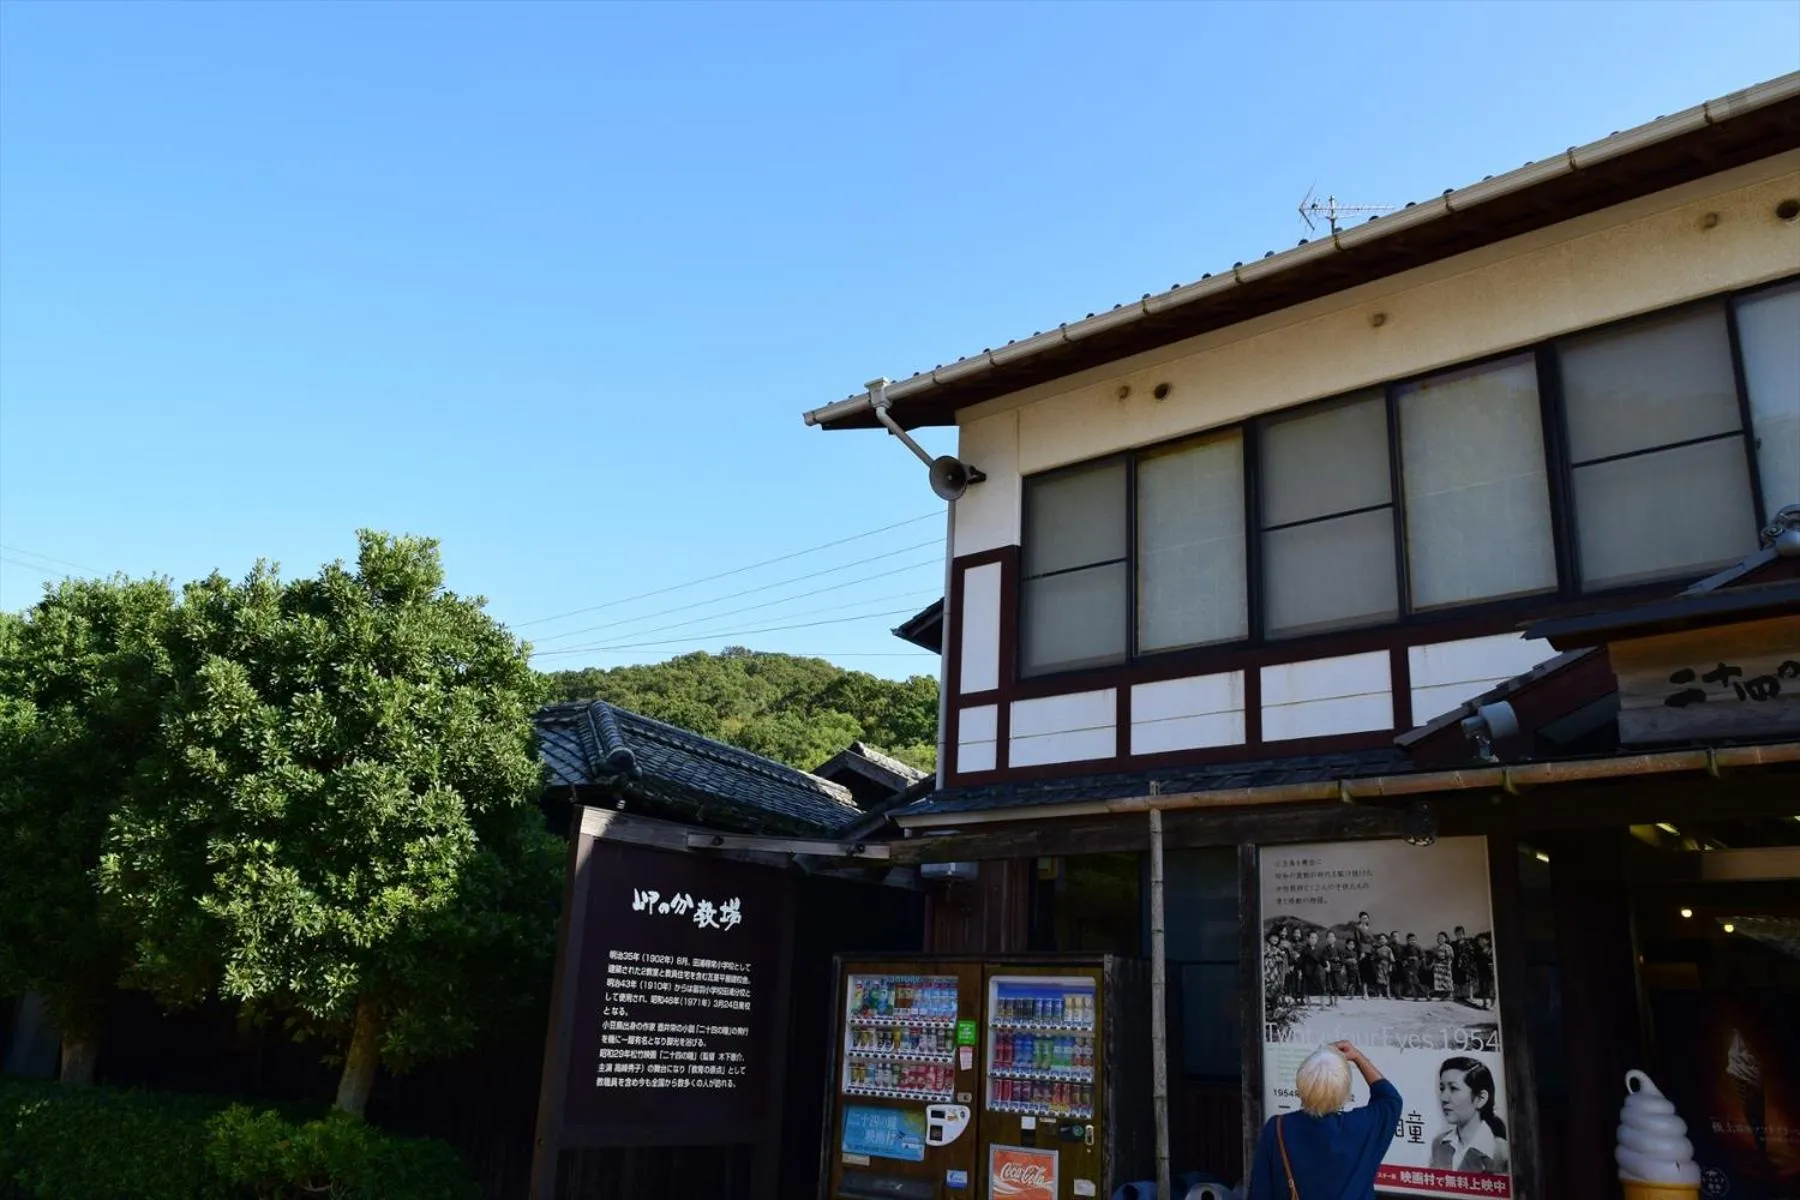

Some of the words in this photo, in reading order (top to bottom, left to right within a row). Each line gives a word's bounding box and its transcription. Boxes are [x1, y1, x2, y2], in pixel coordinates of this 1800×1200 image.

[632, 887, 743, 932] 岬の分教場
[602, 1006, 629, 1016] となる。
[1440, 1028, 1501, 1053] 1954
[1000, 1162, 1046, 1185] Coca-Cola
[1400, 1170, 1506, 1193] 映画村で無料上映中
